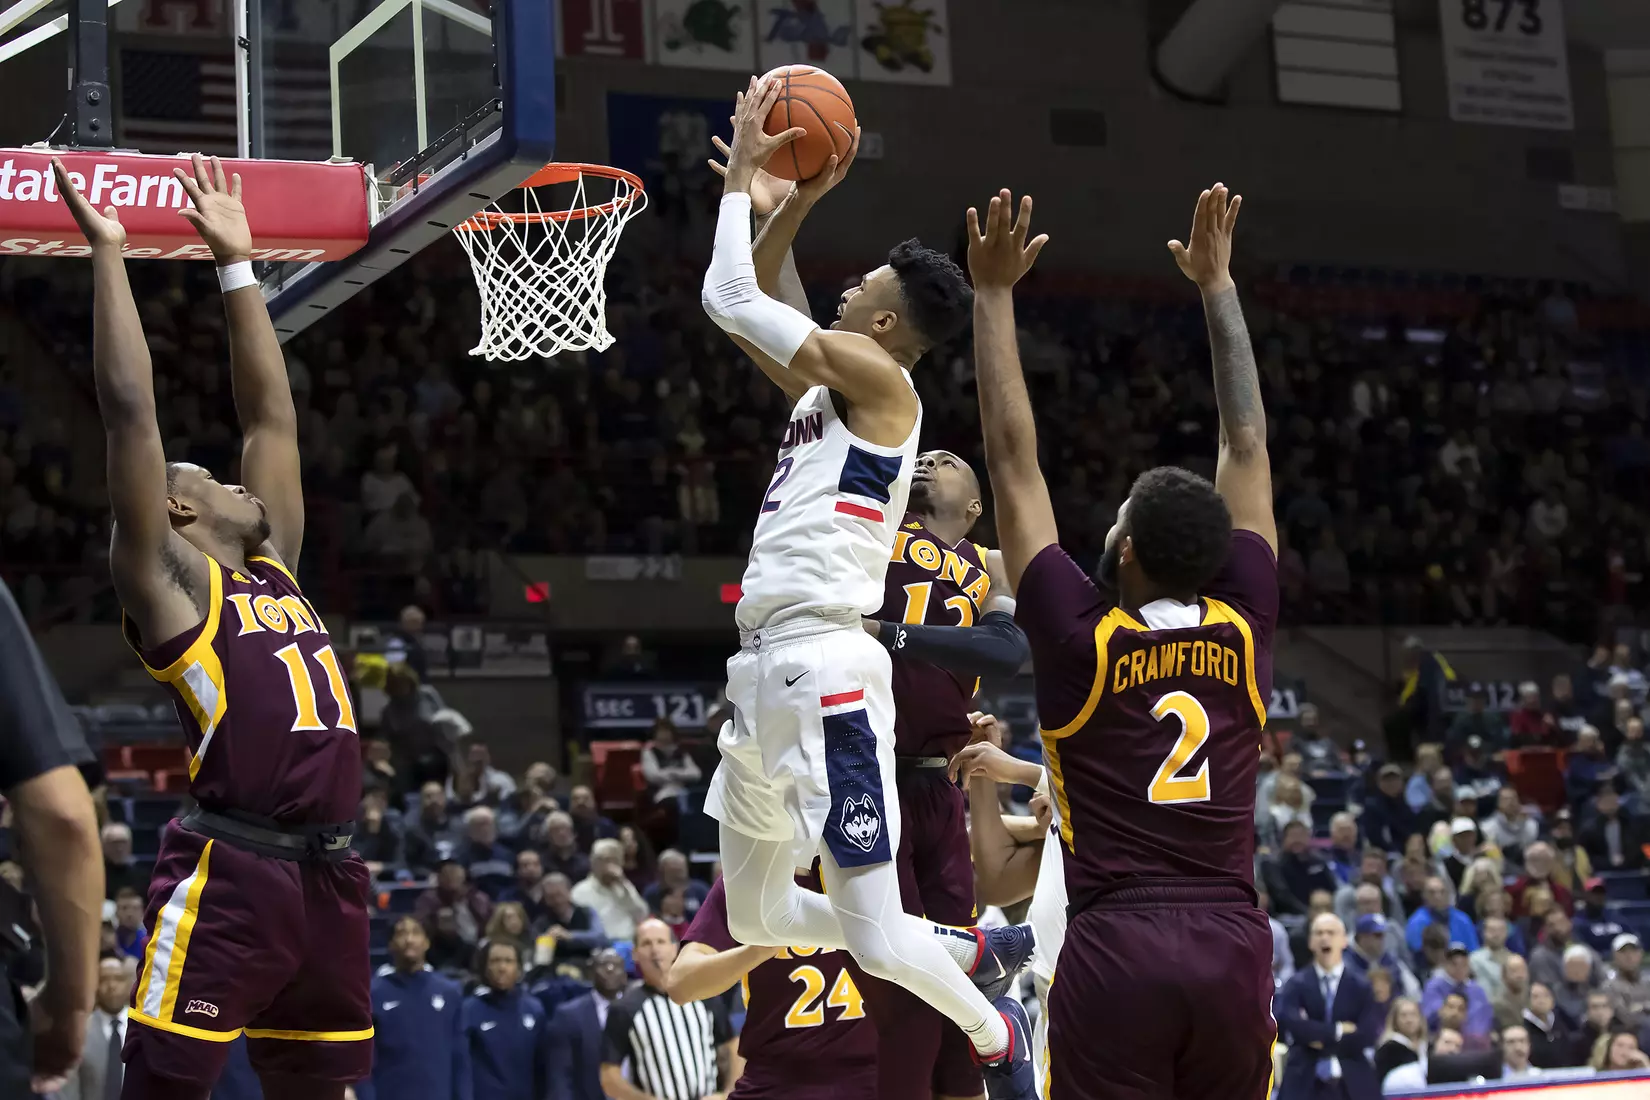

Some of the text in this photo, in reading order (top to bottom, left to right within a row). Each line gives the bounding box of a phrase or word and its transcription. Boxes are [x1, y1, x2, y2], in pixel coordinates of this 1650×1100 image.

[0, 238, 162, 260] Stae
[761, 456, 795, 515] 2
[890, 530, 991, 613] IONA
[226, 593, 329, 637] ION
[273, 641, 357, 735] 11
[1112, 640, 1239, 694] CRAWFORD
[594, 698, 635, 717] SEC
[1147, 690, 1212, 804] 2
[185, 1000, 219, 1018] MAAC
[784, 965, 866, 1028] 24
